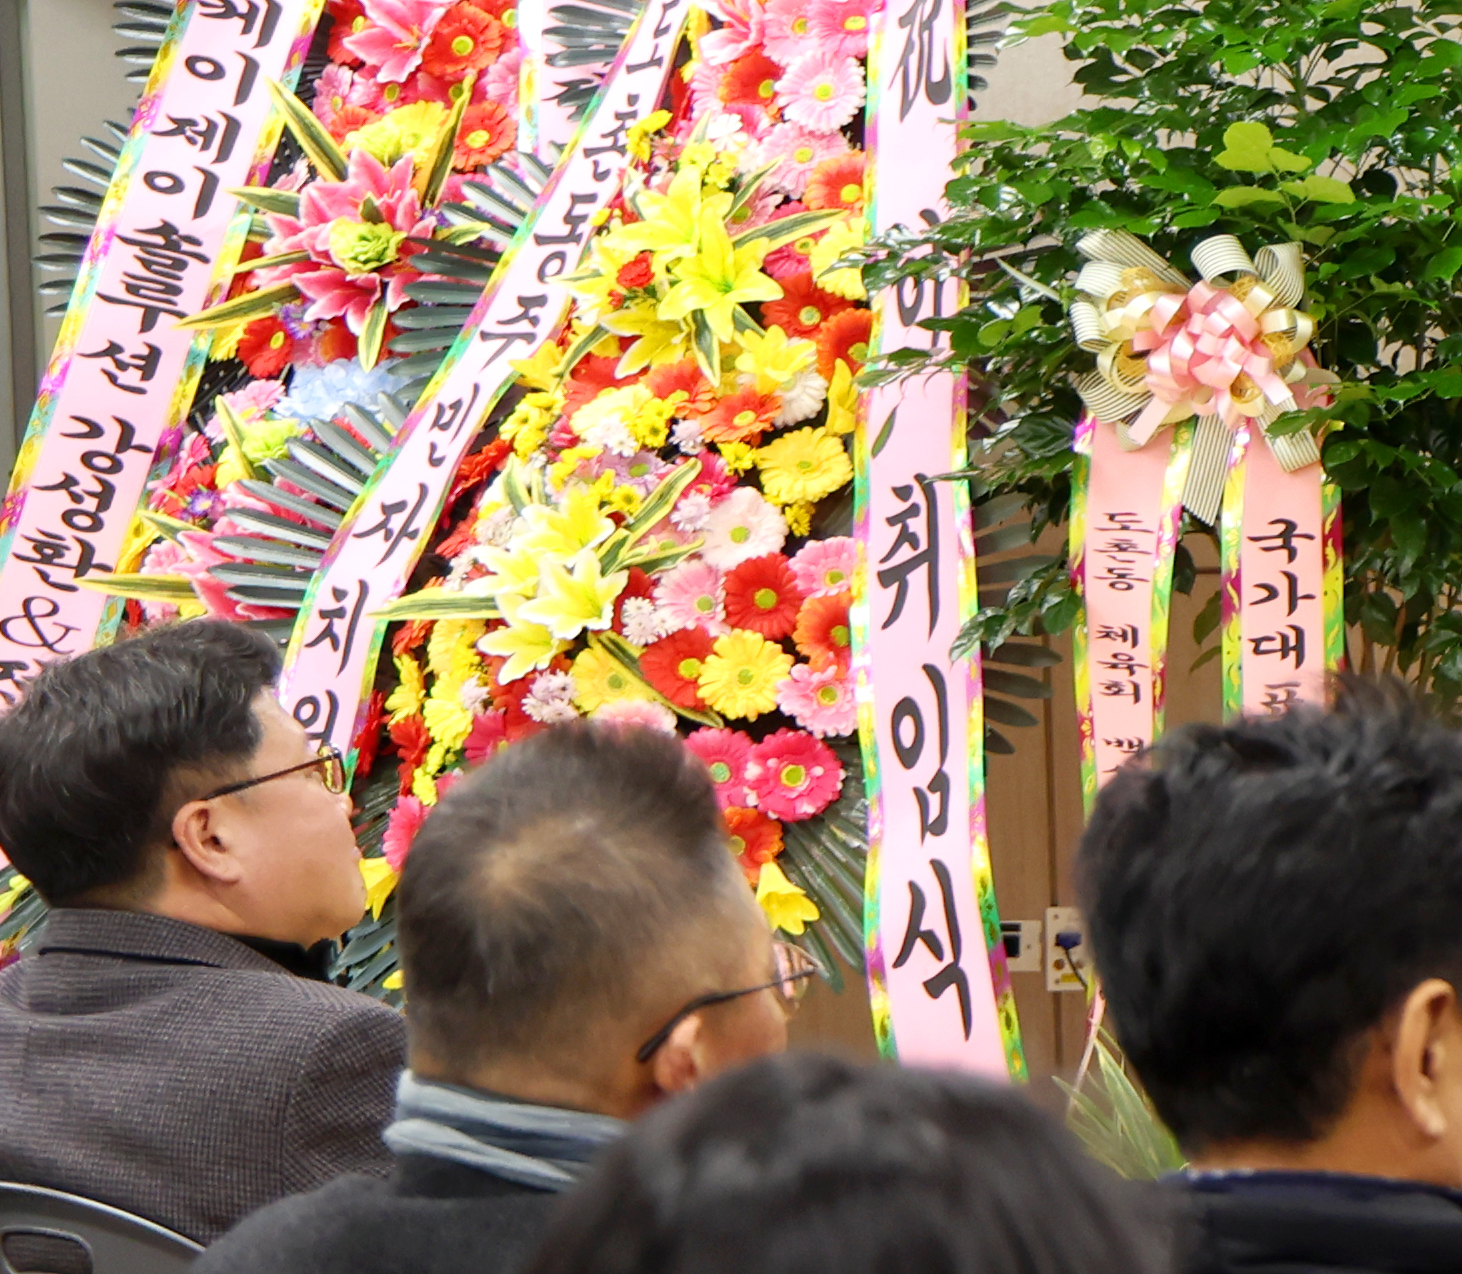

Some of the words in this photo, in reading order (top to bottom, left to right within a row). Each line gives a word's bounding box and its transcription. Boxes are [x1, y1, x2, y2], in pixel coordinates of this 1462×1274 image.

[1094, 511, 1156, 592] 도촌동
[1095, 623, 1150, 705] 체육회
[875, 471, 975, 1043] 취임식
